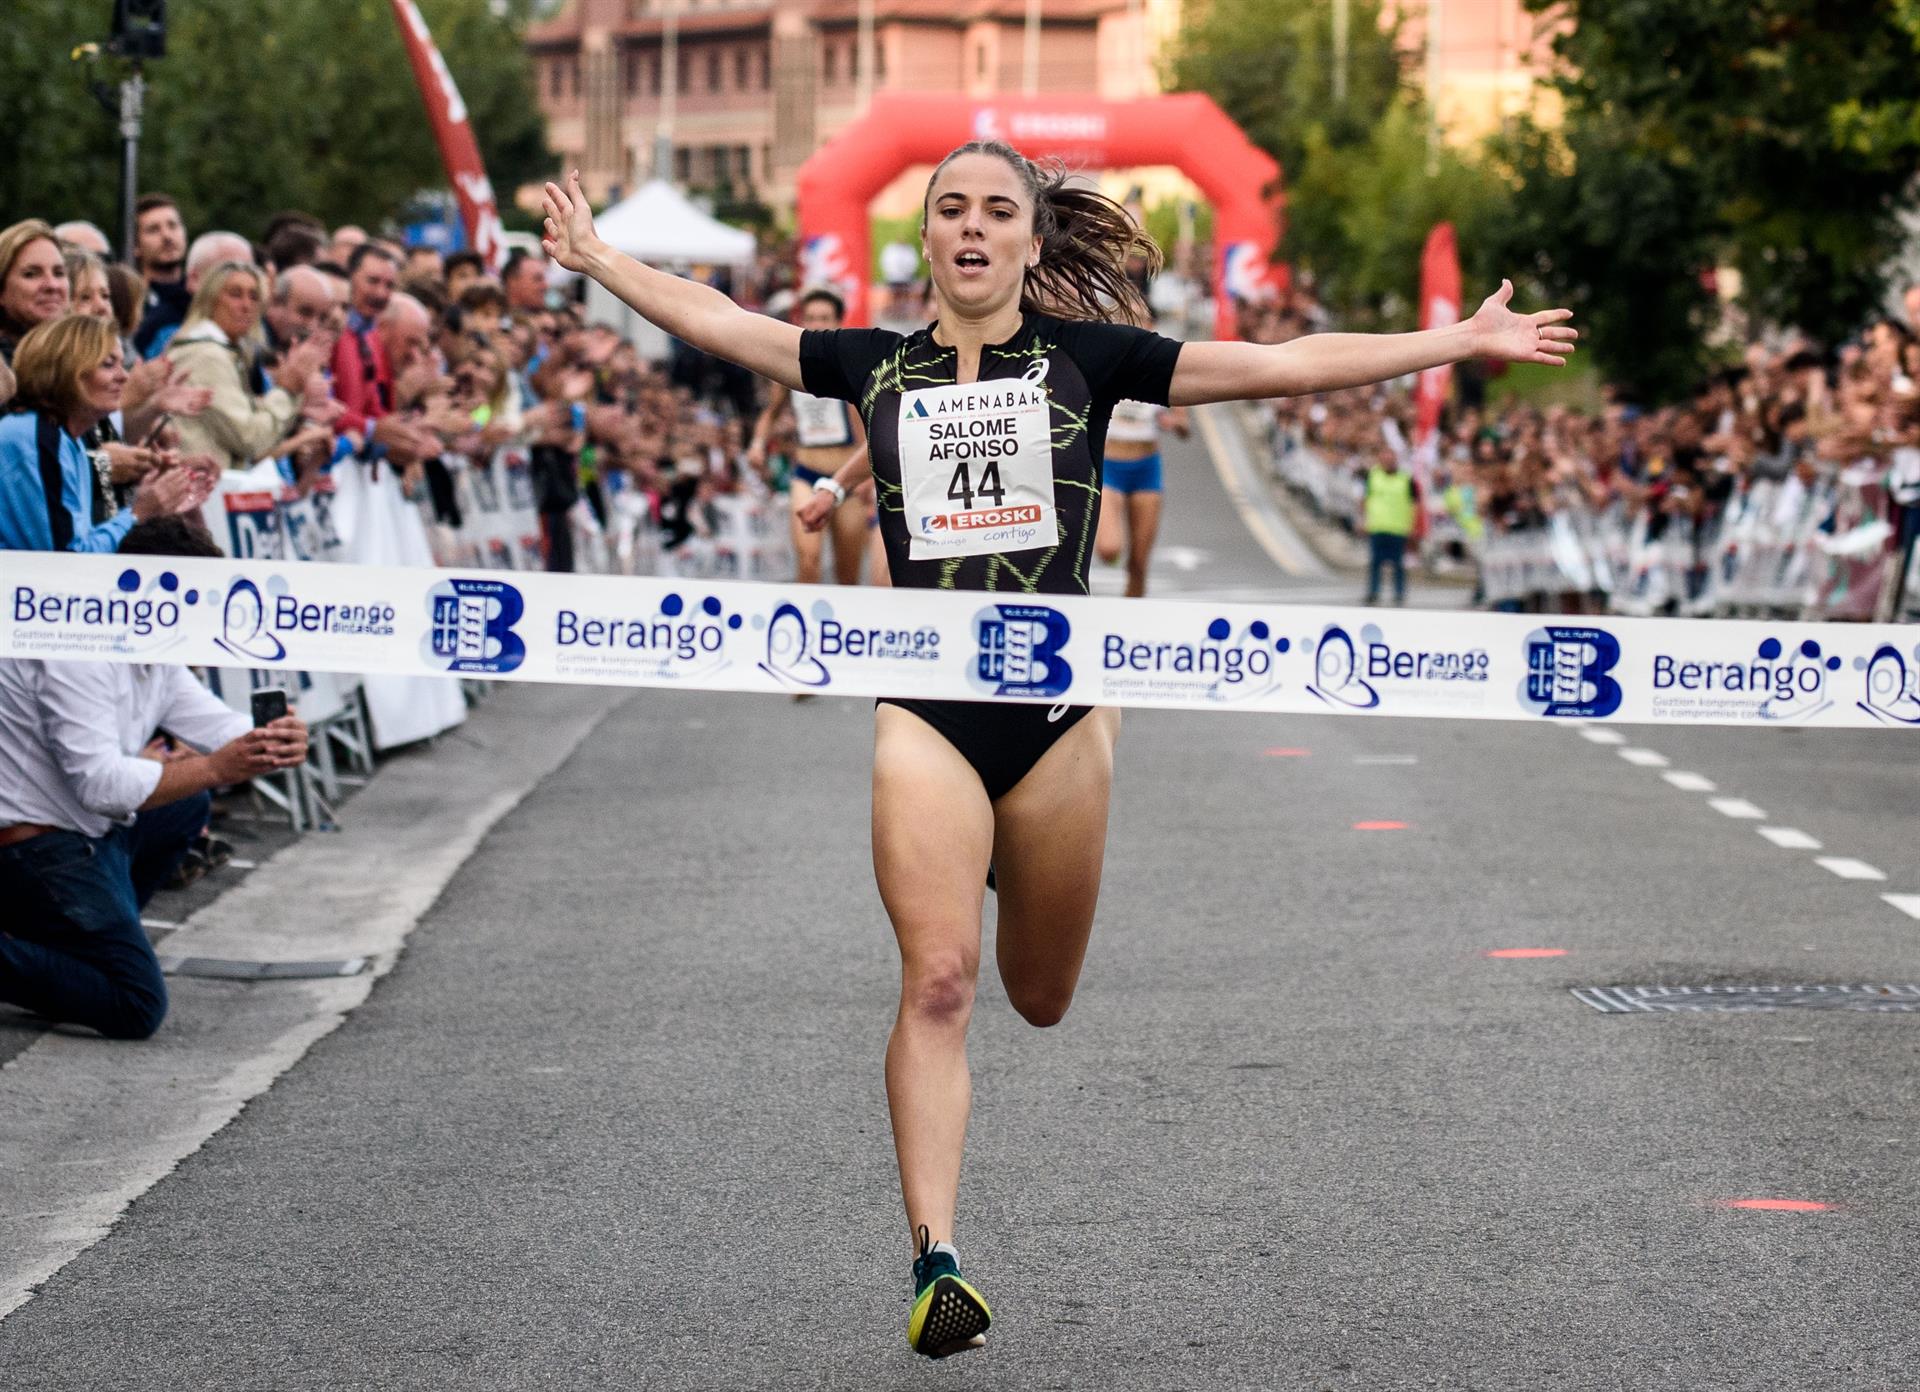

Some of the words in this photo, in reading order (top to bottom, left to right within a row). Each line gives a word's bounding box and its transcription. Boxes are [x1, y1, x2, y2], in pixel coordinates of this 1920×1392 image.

[929, 417, 1017, 440] SALOME
[929, 439, 1019, 461] AFONSO
[947, 461, 1006, 510] 44
[956, 507, 1036, 528] EROSKI
[983, 528, 1037, 544] contigo
[14, 586, 179, 635] Berango
[275, 596, 395, 632] Berango
[558, 610, 722, 660] Berango
[820, 620, 941, 656] Berango
[1104, 635, 1270, 683] Berango
[1369, 643, 1490, 678] Berango
[1653, 655, 1821, 701] Berango
